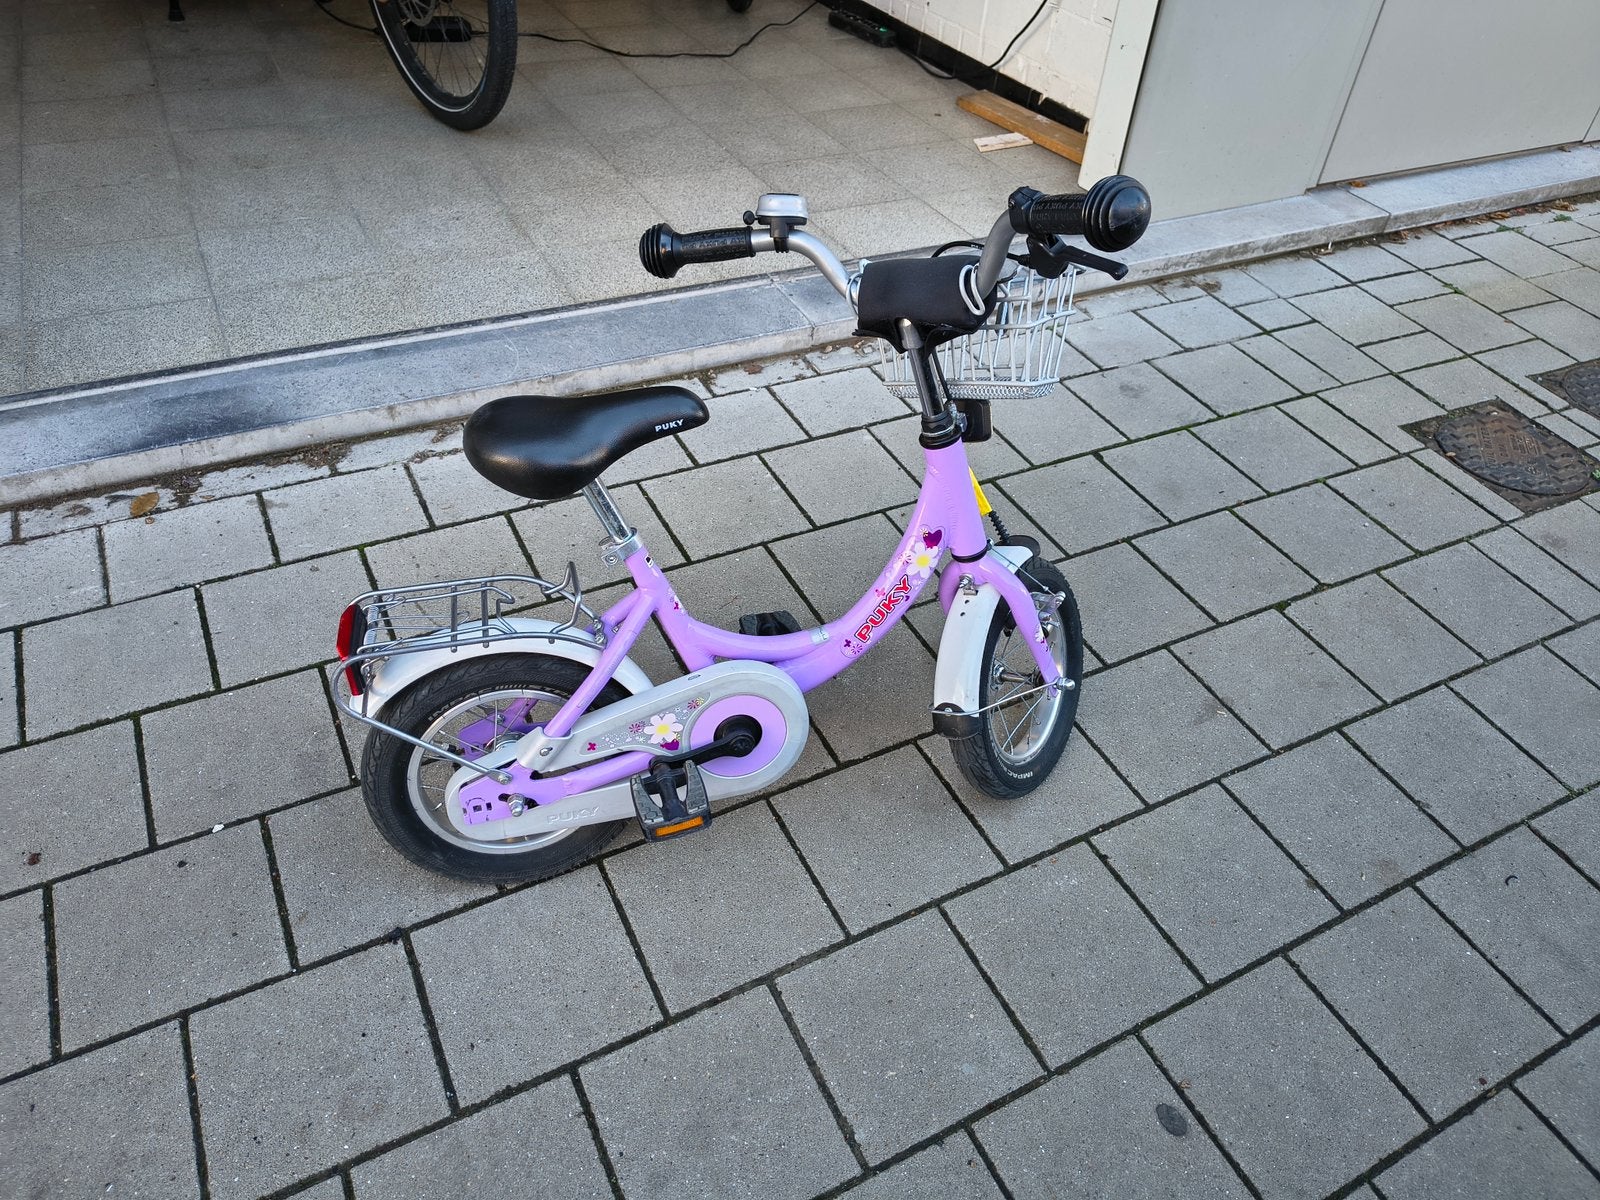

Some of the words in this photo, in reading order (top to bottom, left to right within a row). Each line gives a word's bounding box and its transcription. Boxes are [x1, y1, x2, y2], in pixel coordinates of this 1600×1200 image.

[655, 419, 683, 432] PUKY
[854, 574, 912, 643] PUKY
[428, 687, 492, 721] IMPAC
[1007, 771, 1033, 780] IMPAC
[546, 806, 599, 824] PUKY
